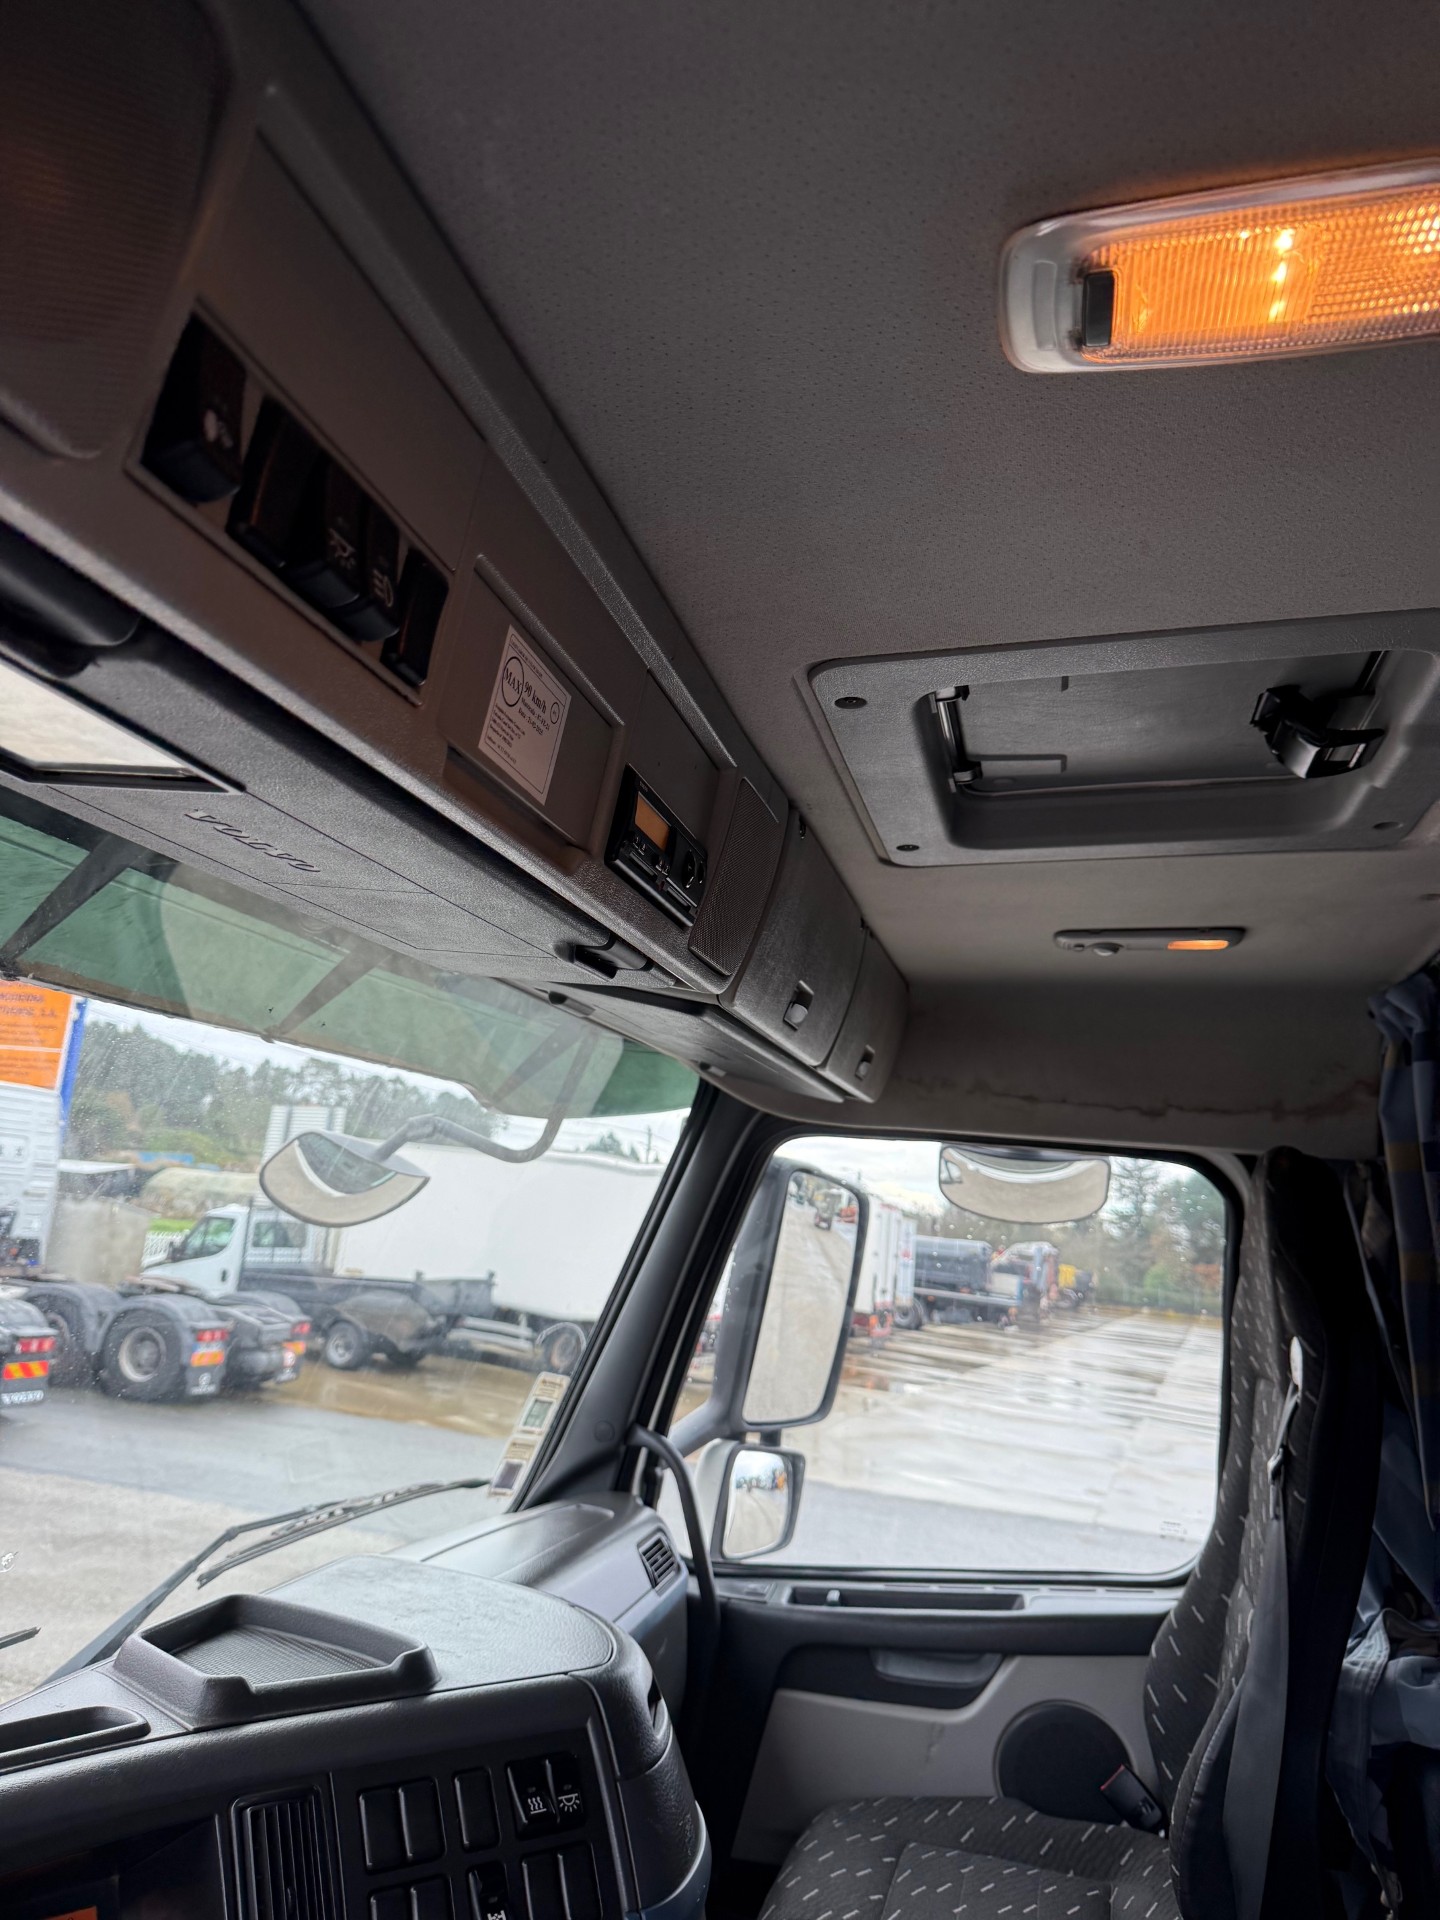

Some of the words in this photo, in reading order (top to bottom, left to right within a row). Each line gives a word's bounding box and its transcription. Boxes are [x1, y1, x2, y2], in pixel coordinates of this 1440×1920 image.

[504, 668, 522, 694] MAX
[524, 682, 533, 697] 90
[532, 690, 547, 714] km/h
[184, 809, 321, 873] VOLVO
